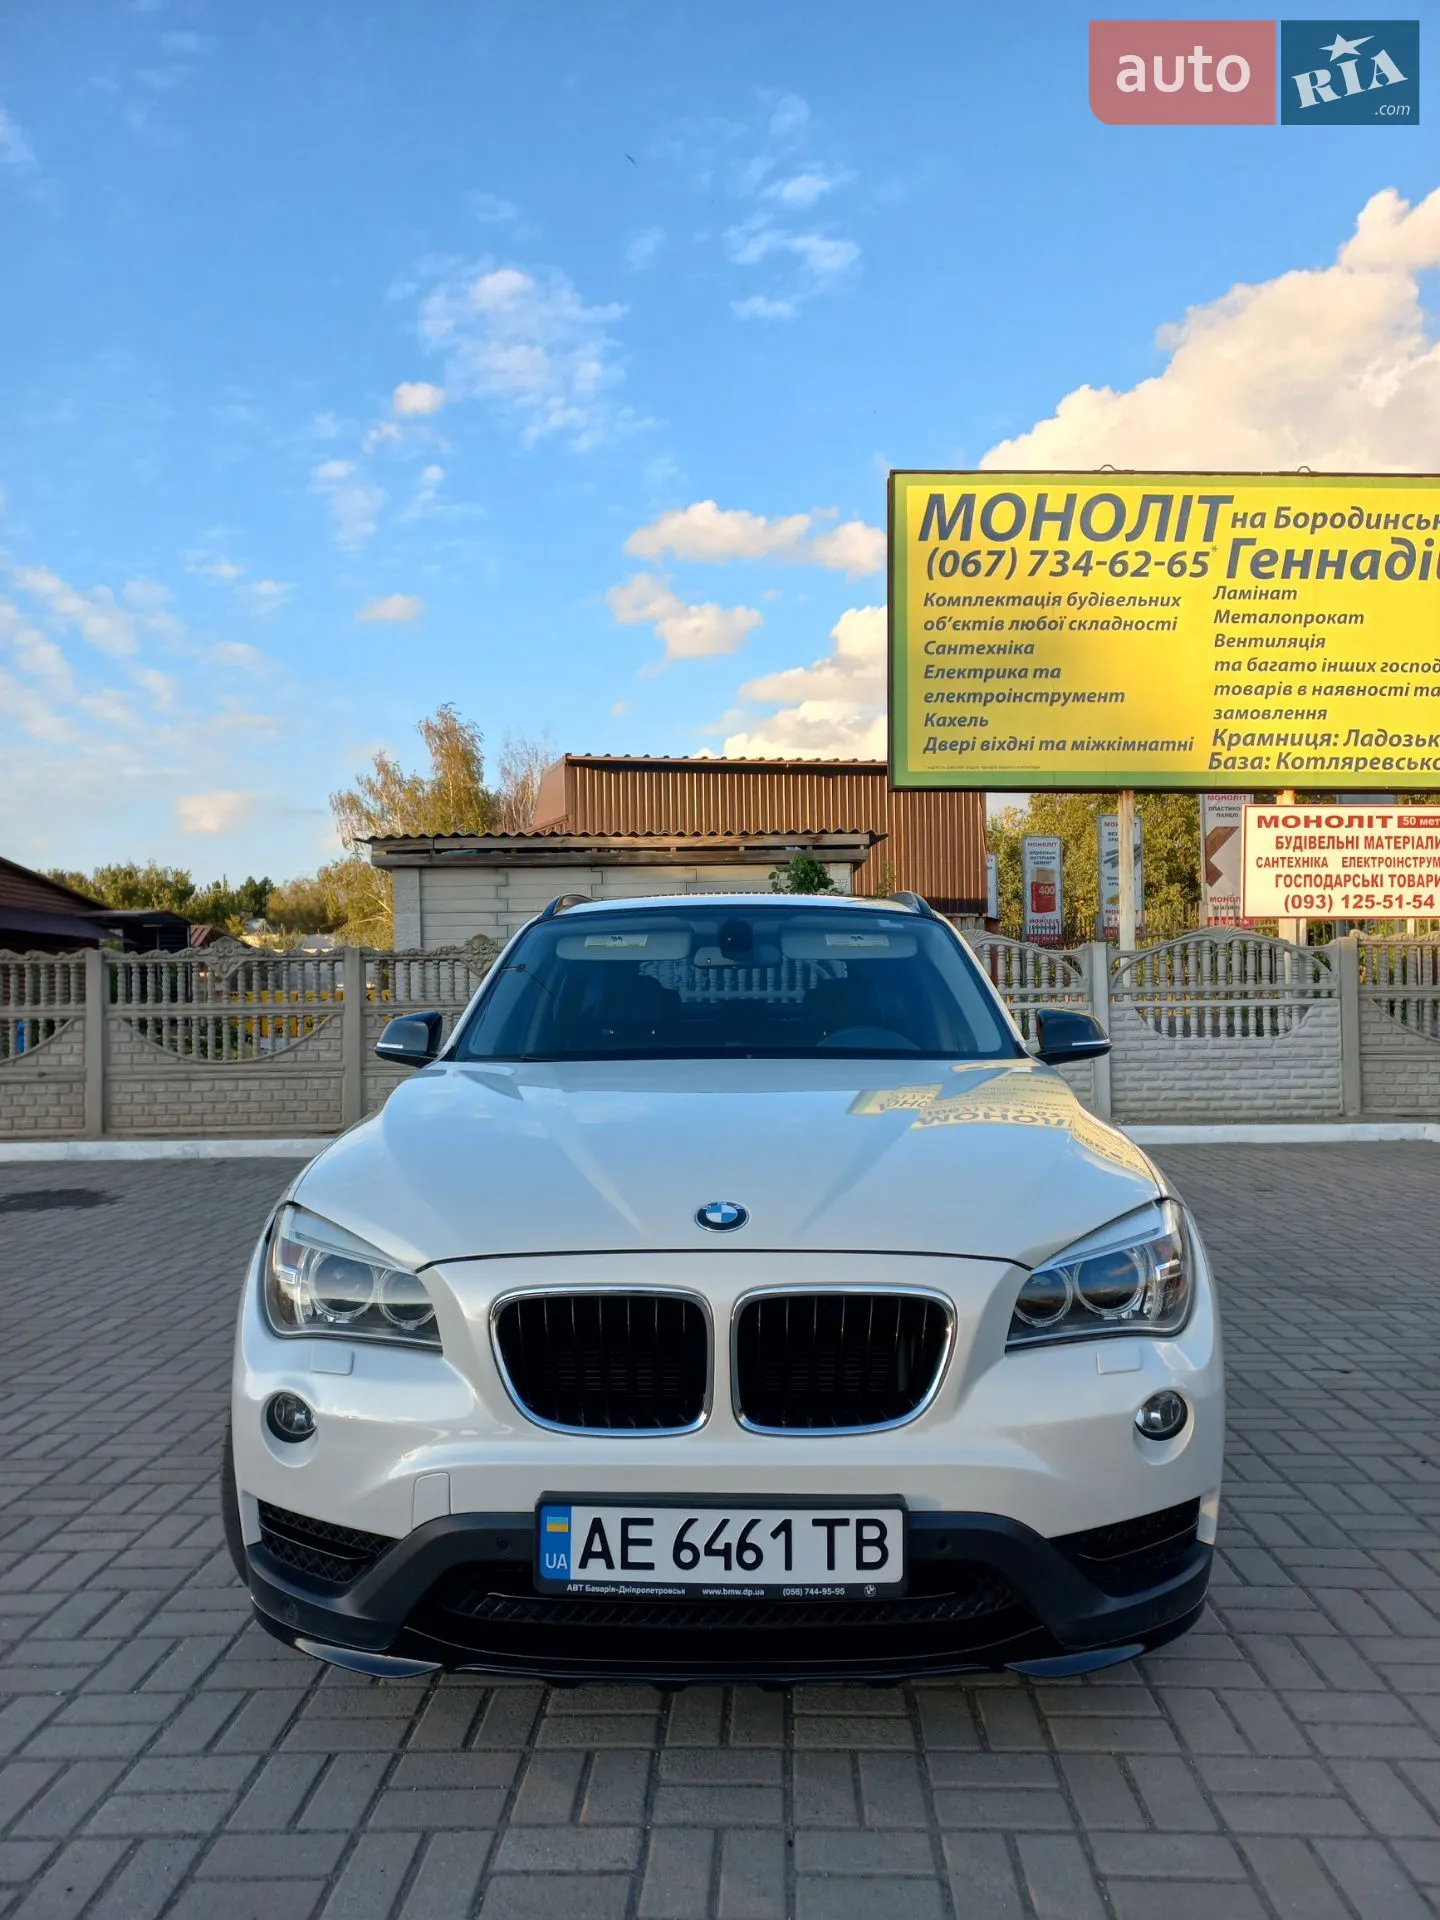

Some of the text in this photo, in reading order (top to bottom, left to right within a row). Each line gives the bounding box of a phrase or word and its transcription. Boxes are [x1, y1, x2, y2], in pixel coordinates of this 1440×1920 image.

[918, 493, 1235, 544] МОНОЛІТ
[1231, 511, 1266, 529] на
[926, 547, 1017, 580] (067)
[1226, 537, 1440, 580] Геннаді
[924, 592, 1181, 610] Комплектація будівельних
[1213, 586, 1297, 600] Ламінат
[1008, 616, 1065, 631] любої
[1069, 616, 1177, 631] складності
[1214, 610, 1364, 627] Металопрокат
[924, 641, 1034, 655] Сантехніка
[1215, 634, 1325, 650] Вентиляція
[1215, 661, 1242, 671] та
[1247, 657, 1317, 672] багато
[1322, 658, 1376, 672] інших
[924, 665, 1061, 683] Електрика та
[924, 688, 1124, 706] електроінструмент
[1214, 682, 1440, 699] товарів в наявності та
[924, 713, 988, 727] Кахель
[1214, 709, 1327, 719] замовлення
[923, 737, 976, 754] Двері
[1039, 740, 1066, 750] та
[1071, 737, 1193, 751] міжкімнатні
[1212, 729, 1440, 753] Крамниця: Ладозьк
[1208, 750, 1440, 774] База: Котляревсько
[1257, 815, 1393, 828] МОНОЛІТ
[1402, 816, 1416, 826] 50
[1275, 835, 1359, 852] БУДІВЕЛЬНІ
[1256, 857, 1440, 868] САНТЕХНІКА ЕЛЕКТРОІНСТРУМ
[1275, 873, 1383, 890] ГОСПОДАРСЬКІ
[1039, 886, 1054, 895] 400
[1284, 894, 1435, 913] (093) 125-51-54
[578, 1517, 888, 1571] AE 6461 TB
[546, 1553, 567, 1568] UA
[702, 1588, 764, 1597] www.bmw.dp.ua
